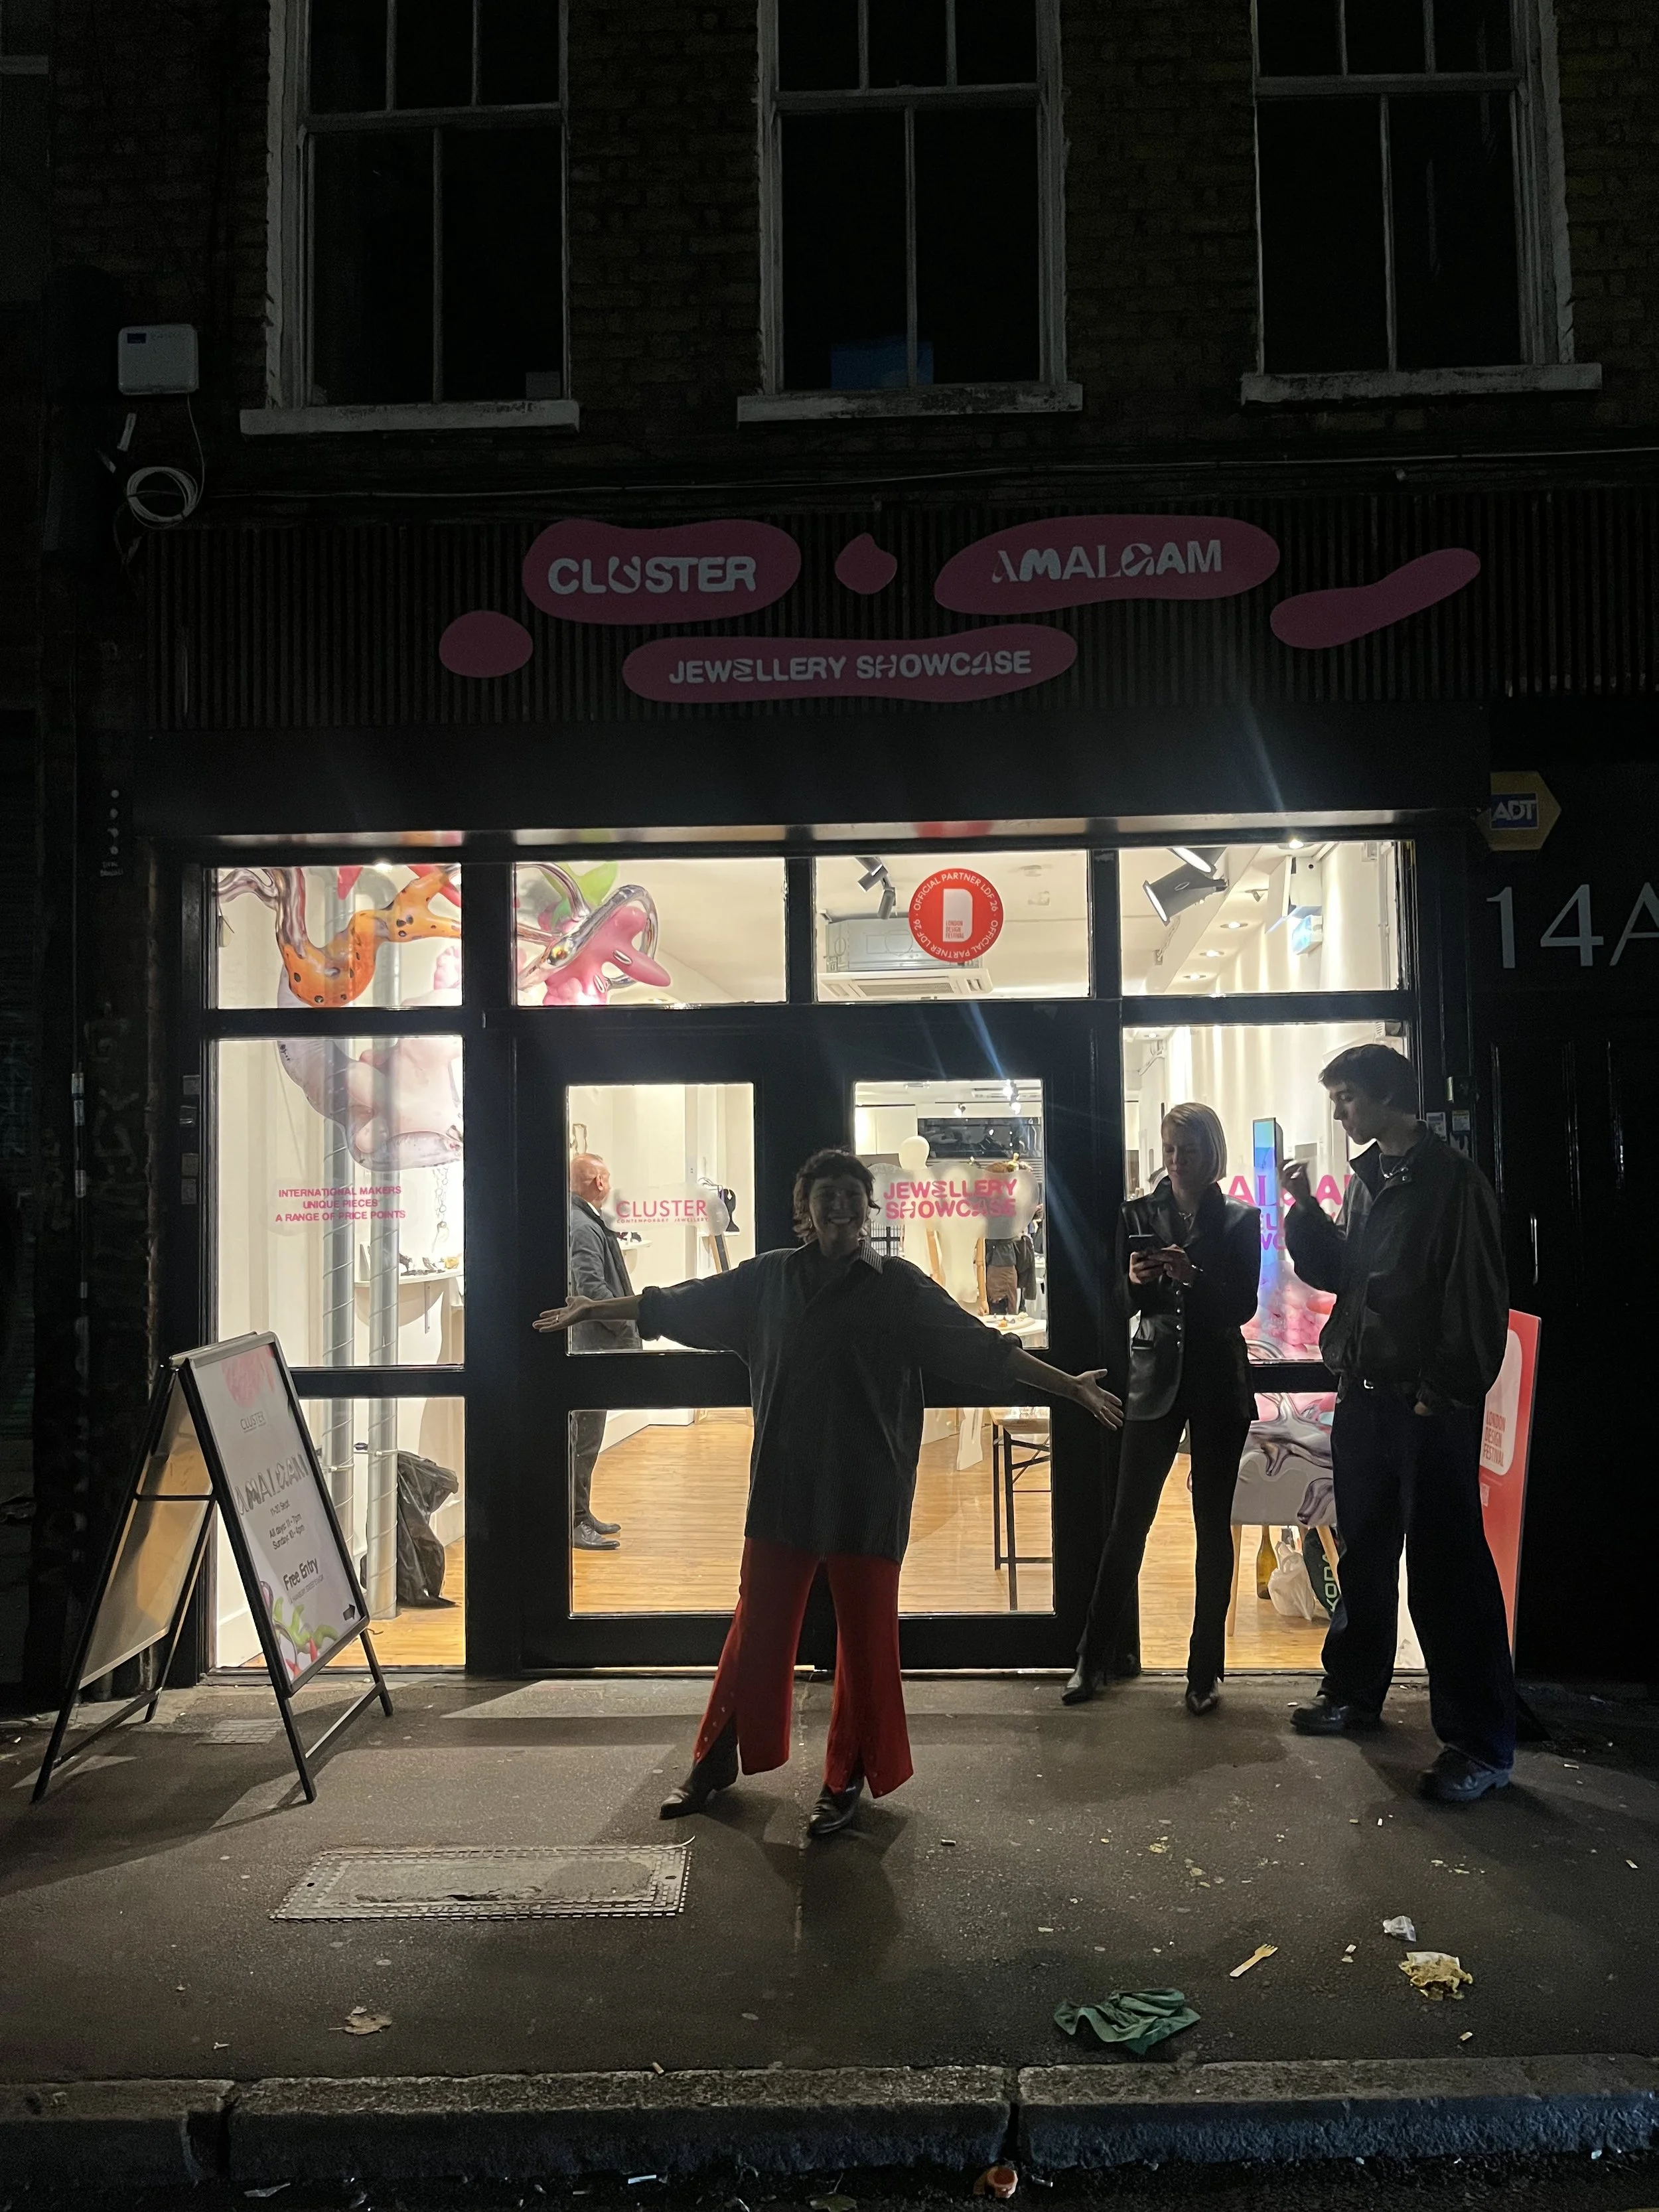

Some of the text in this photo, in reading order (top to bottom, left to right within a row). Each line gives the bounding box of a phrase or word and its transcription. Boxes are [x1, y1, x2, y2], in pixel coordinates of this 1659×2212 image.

[991, 539, 1223, 584] AMALGAM
[548, 555, 757, 595] CLUSTER
[669, 650, 1032, 684] JEWELLERY SHOWCASE
[1492, 798, 1538, 822] ADT
[913, 877, 941, 911] OFFICIAL
[941, 871, 981, 887] PARTNER
[980, 883, 995, 900] LDF
[1486, 881, 1659, 969] 14A
[916, 931, 931, 948] LDF
[971, 920, 999, 953] OFFICIAL
[930, 944, 971, 959] PARTNER
[279, 1185, 402, 1197] INTERNATIONAL MAKERS
[883, 1179, 1017, 1200] JEWELLERY
[303, 1199, 378, 1209] UNIQUE PIECES
[615, 1199, 708, 1218] CLUSTER
[885, 1198, 1017, 1219] SHOWCASE
[285, 1213, 319, 1222] RANGE
[322, 1213, 336, 1221] OF
[338, 1211, 368, 1220] PRICE
[370, 1210, 406, 1219] POINTS
[240, 1411, 266, 1430] CLUSTER
[1486, 1410, 1506, 1432] LONDON
[1484, 1428, 1502, 1449] DESIGN
[1483, 1443, 1504, 1467] FESTIVAL
[283, 1574, 301, 1591] Free
[299, 1558, 319, 1580] Entry
